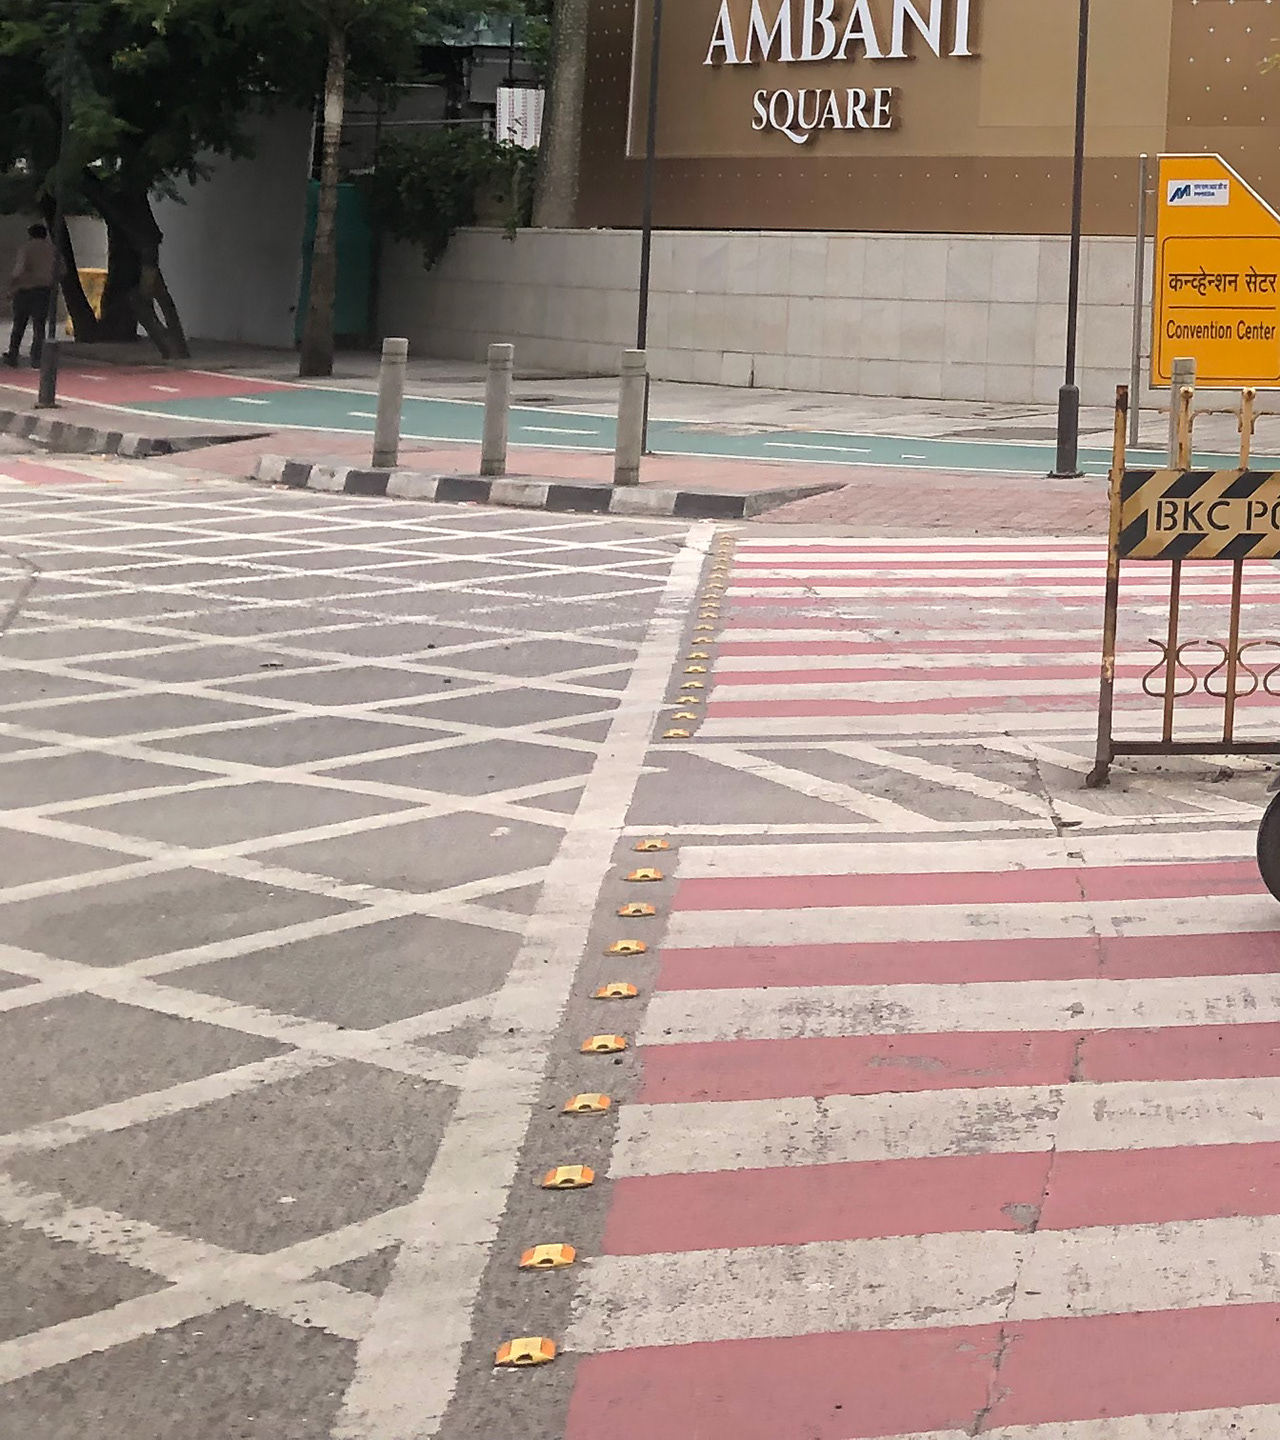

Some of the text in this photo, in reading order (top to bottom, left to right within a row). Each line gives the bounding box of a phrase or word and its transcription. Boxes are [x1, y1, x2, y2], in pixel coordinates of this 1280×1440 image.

[751, 86, 893, 145] SQUARE
[1166, 319, 1276, 341] Convention Center
[1155, 500, 1231, 531] BKC
